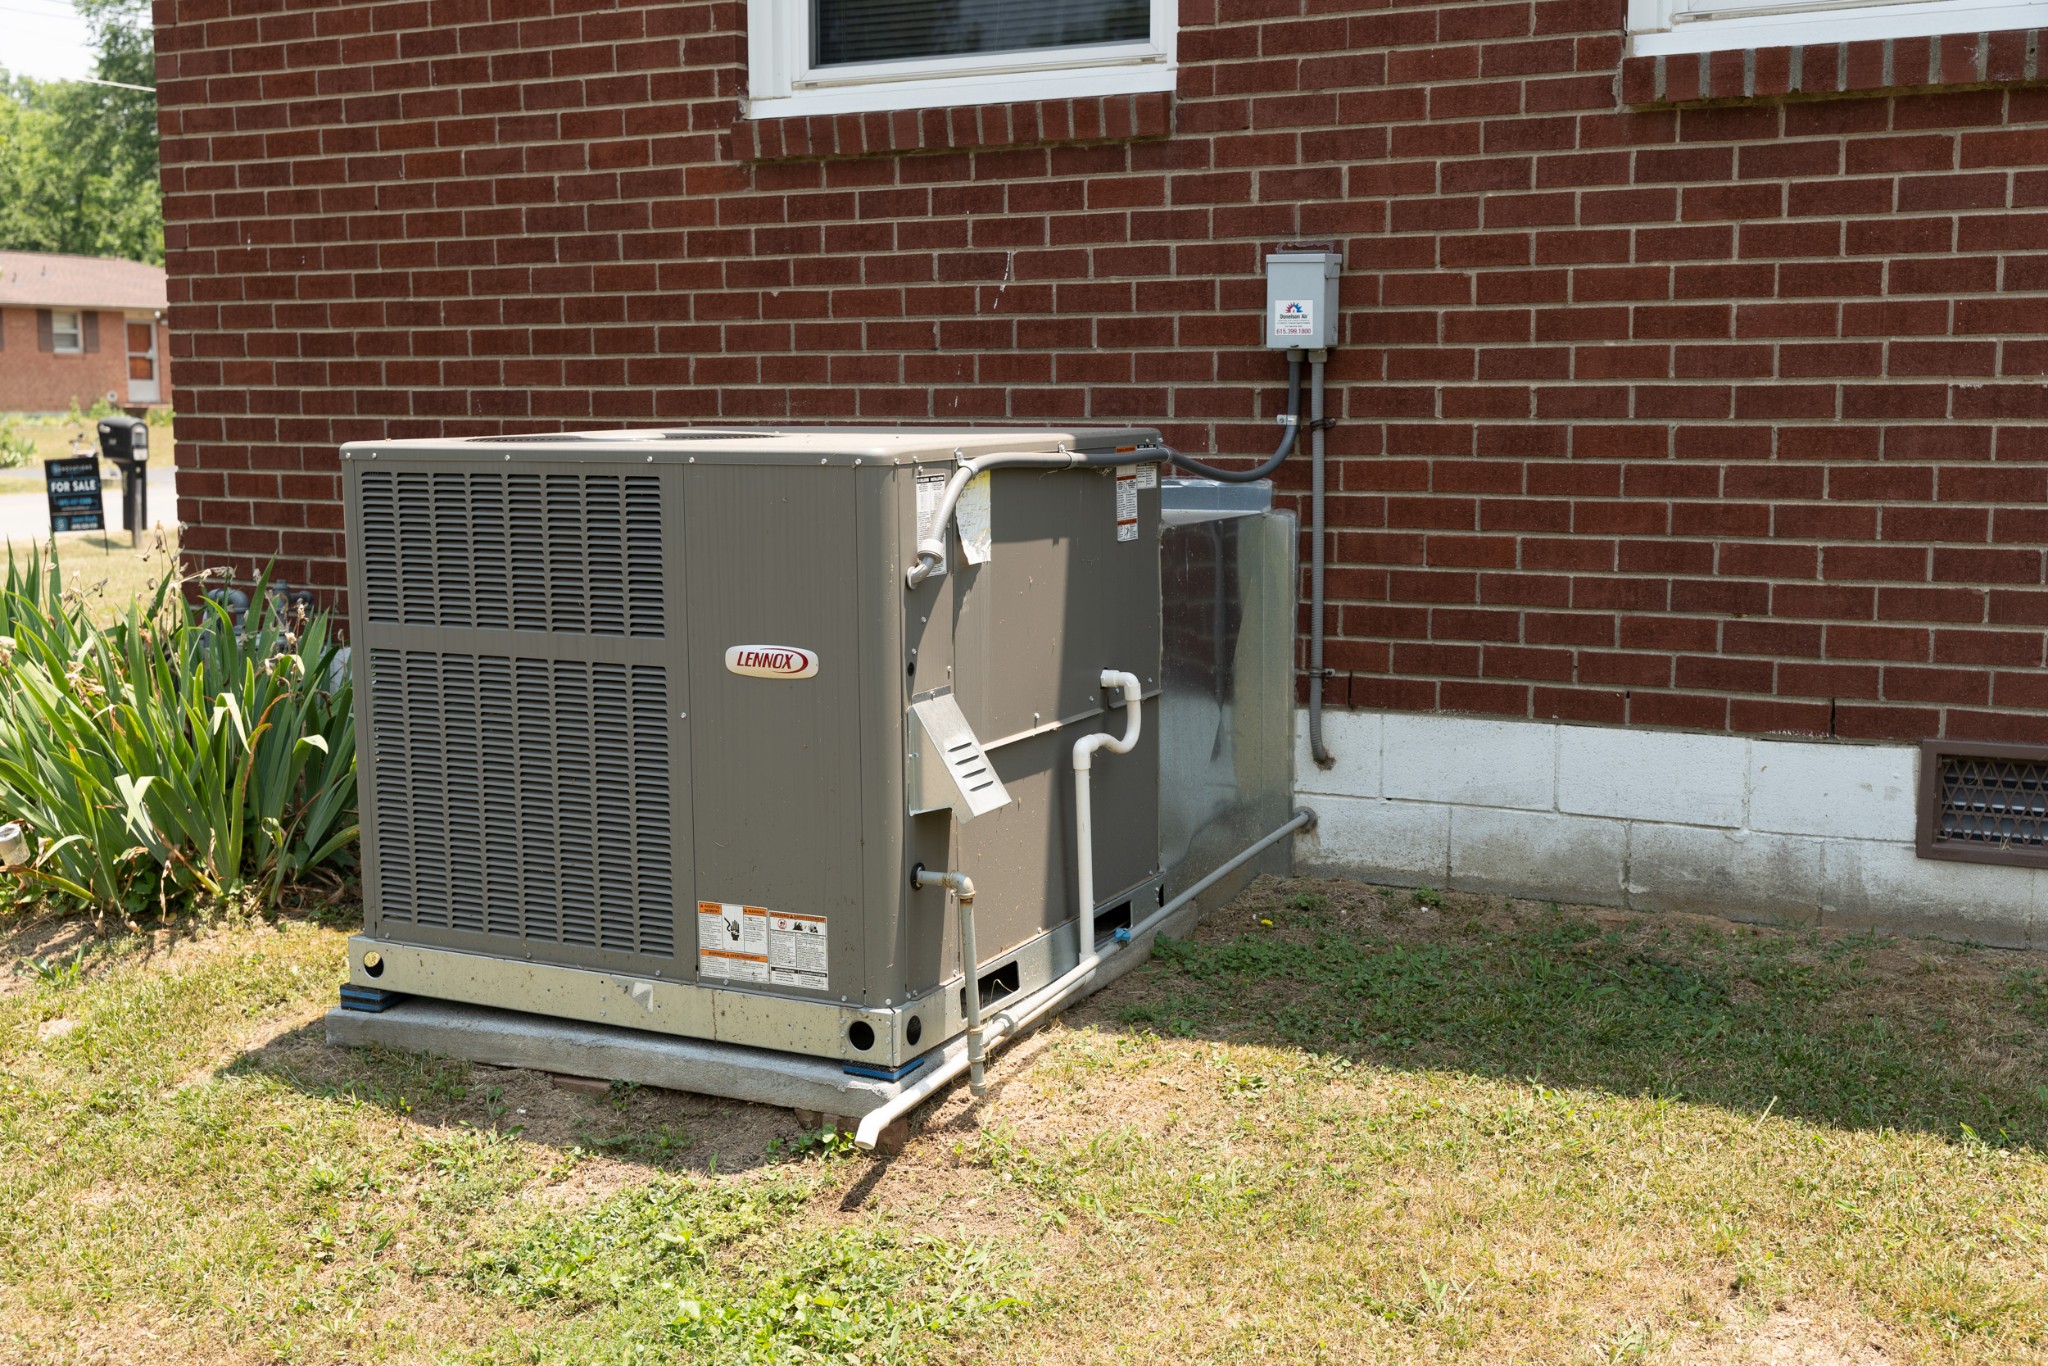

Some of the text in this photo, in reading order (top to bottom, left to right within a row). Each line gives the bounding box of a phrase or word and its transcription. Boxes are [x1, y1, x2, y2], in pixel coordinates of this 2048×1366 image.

[51, 479, 96, 493] FOR SALE
[736, 651, 794, 669] LENNOX
